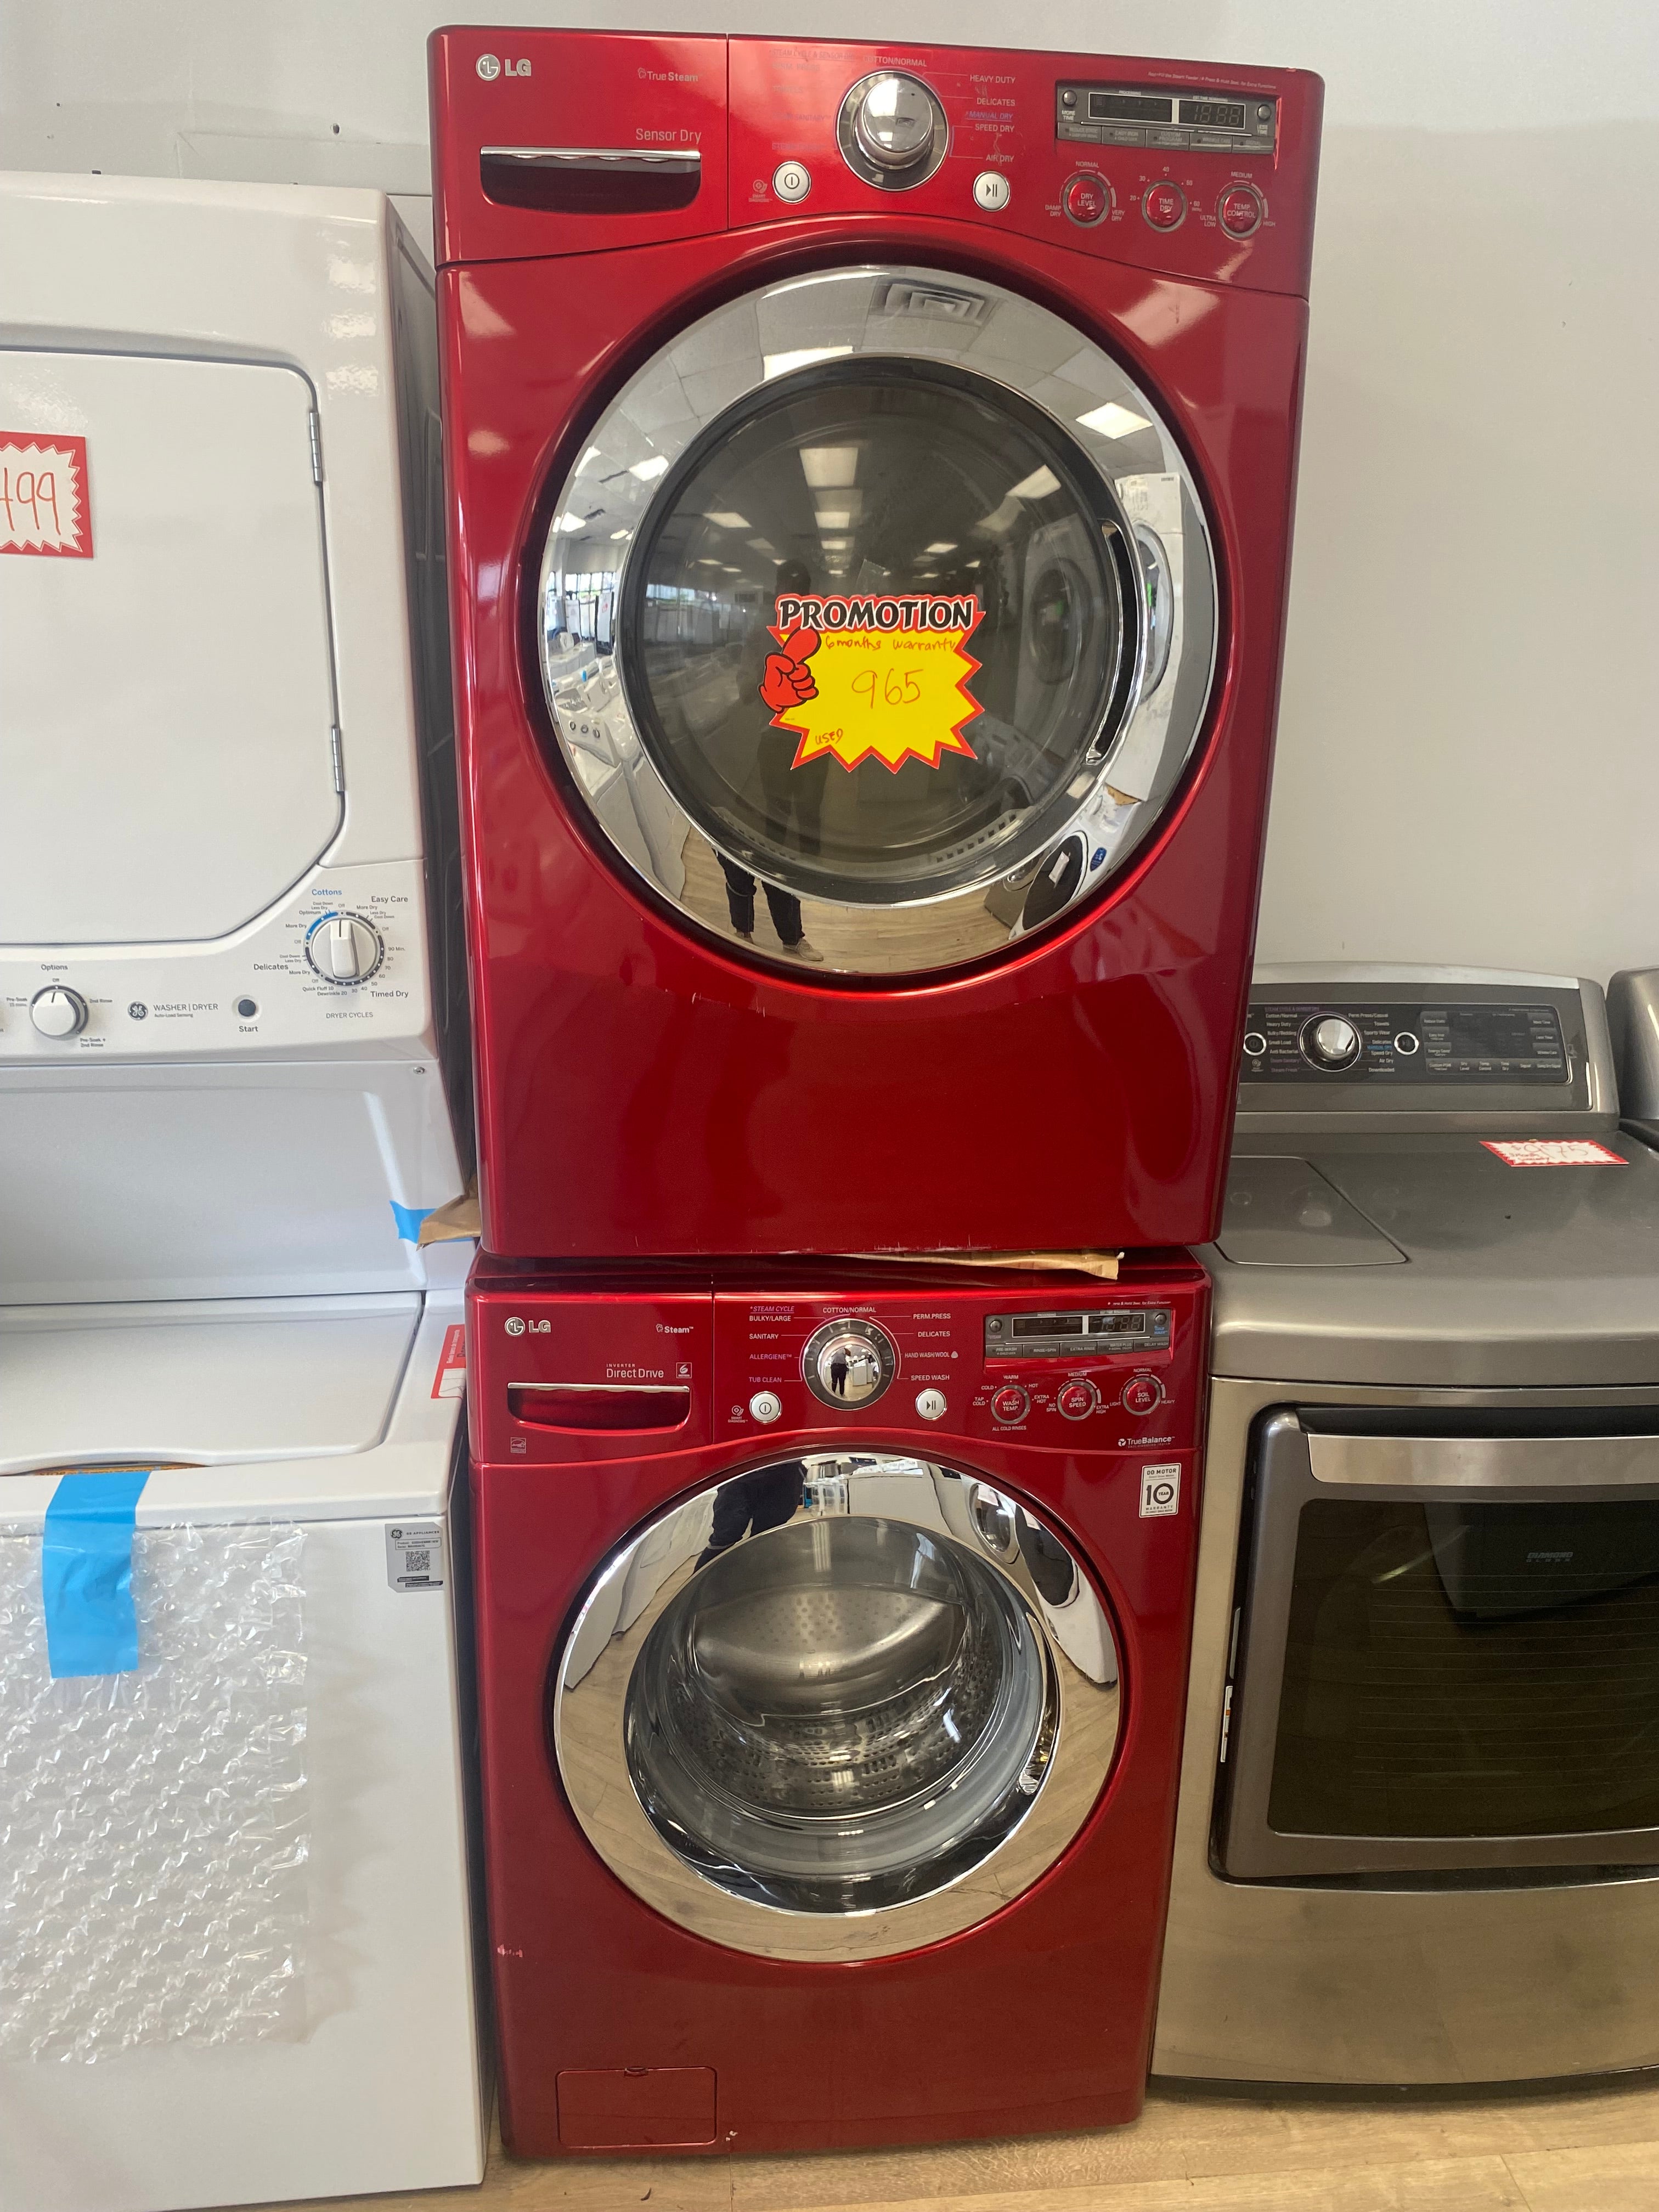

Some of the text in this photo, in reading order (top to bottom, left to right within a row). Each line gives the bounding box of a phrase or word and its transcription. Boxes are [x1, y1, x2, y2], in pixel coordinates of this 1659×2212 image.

[505, 59, 531, 76] LG
[970, 74, 994, 83] HEAVY
[977, 98, 1015, 106] DELICATES
[975, 123, 998, 132] SPEED
[636, 128, 702, 144] Sensor Dry
[1000, 154, 1014, 162] DRY
[777, 598, 974, 631] PROMOTION
[893, 637, 956, 652] warranty
[851, 668, 924, 709] 965
[815, 728, 844, 745] USED
[396, 990, 409, 998] Dry
[528, 1319, 551, 1333] LG
[606, 1368, 664, 1379] Direct Drive
[1146, 1483, 1174, 1505] 10
